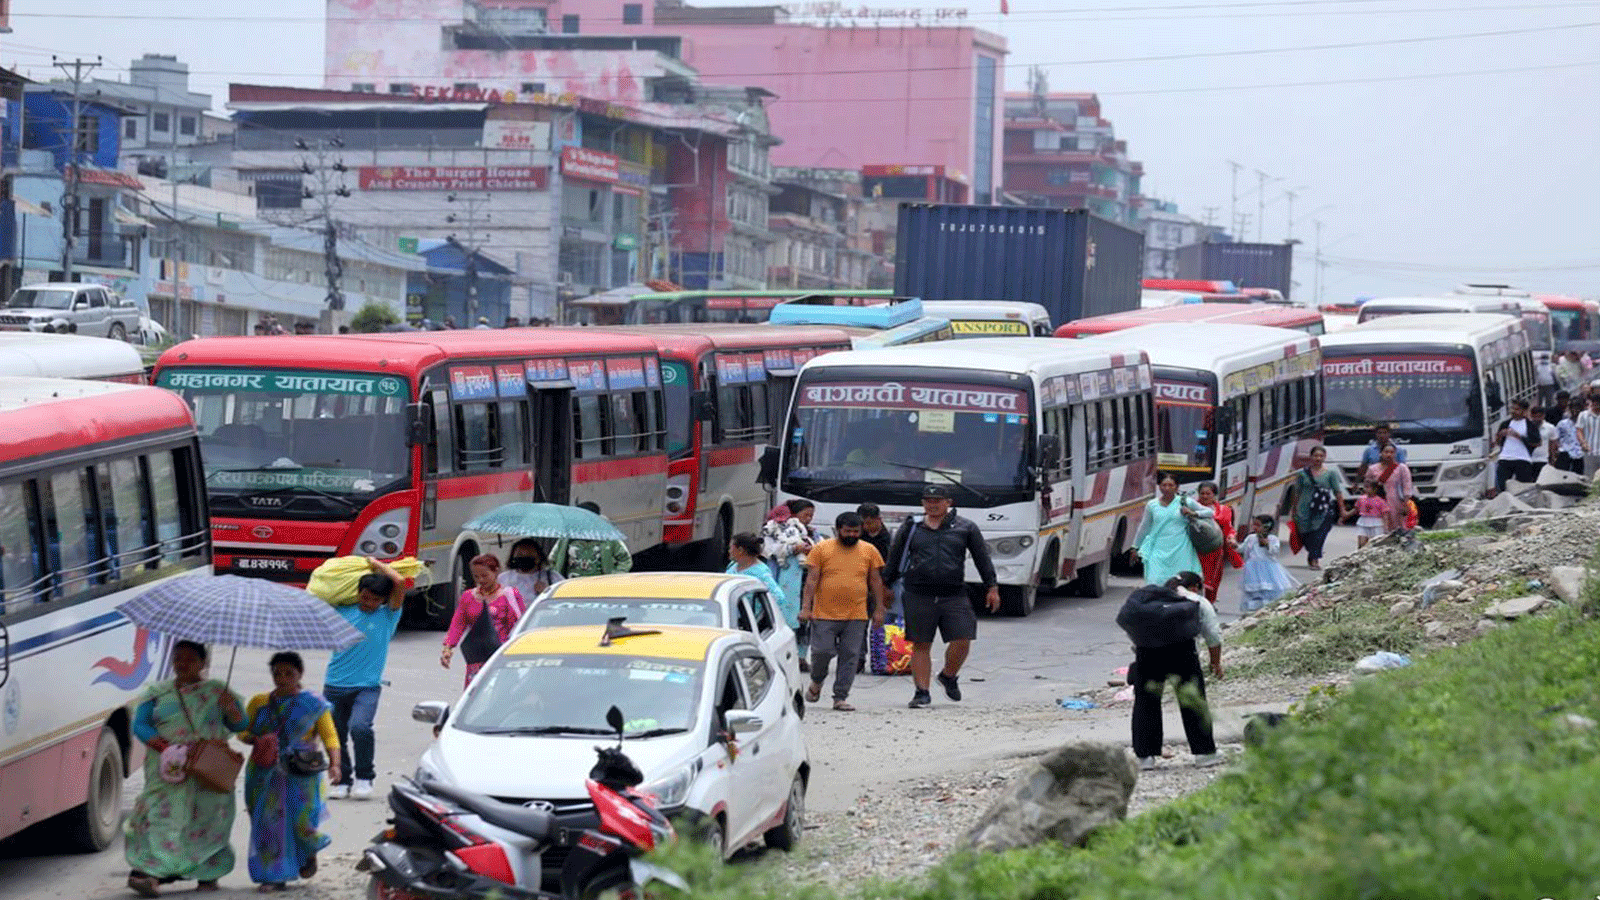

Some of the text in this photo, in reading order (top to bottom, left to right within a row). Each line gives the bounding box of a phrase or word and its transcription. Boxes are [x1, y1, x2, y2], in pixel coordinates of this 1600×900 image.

[405, 167, 531, 179] The Burger House
[368, 179, 537, 190] And Crunchy Fried Chicken
[953, 323, 1022, 332] ANSPORT
[1322, 358, 1373, 376] ागमती
[1375, 360, 1447, 373] यातायात
[169, 373, 266, 389] महानगर
[275, 375, 375, 393] यातायात
[805, 382, 1018, 410] बागमती यातायात
[250, 497, 282, 506] TATA
